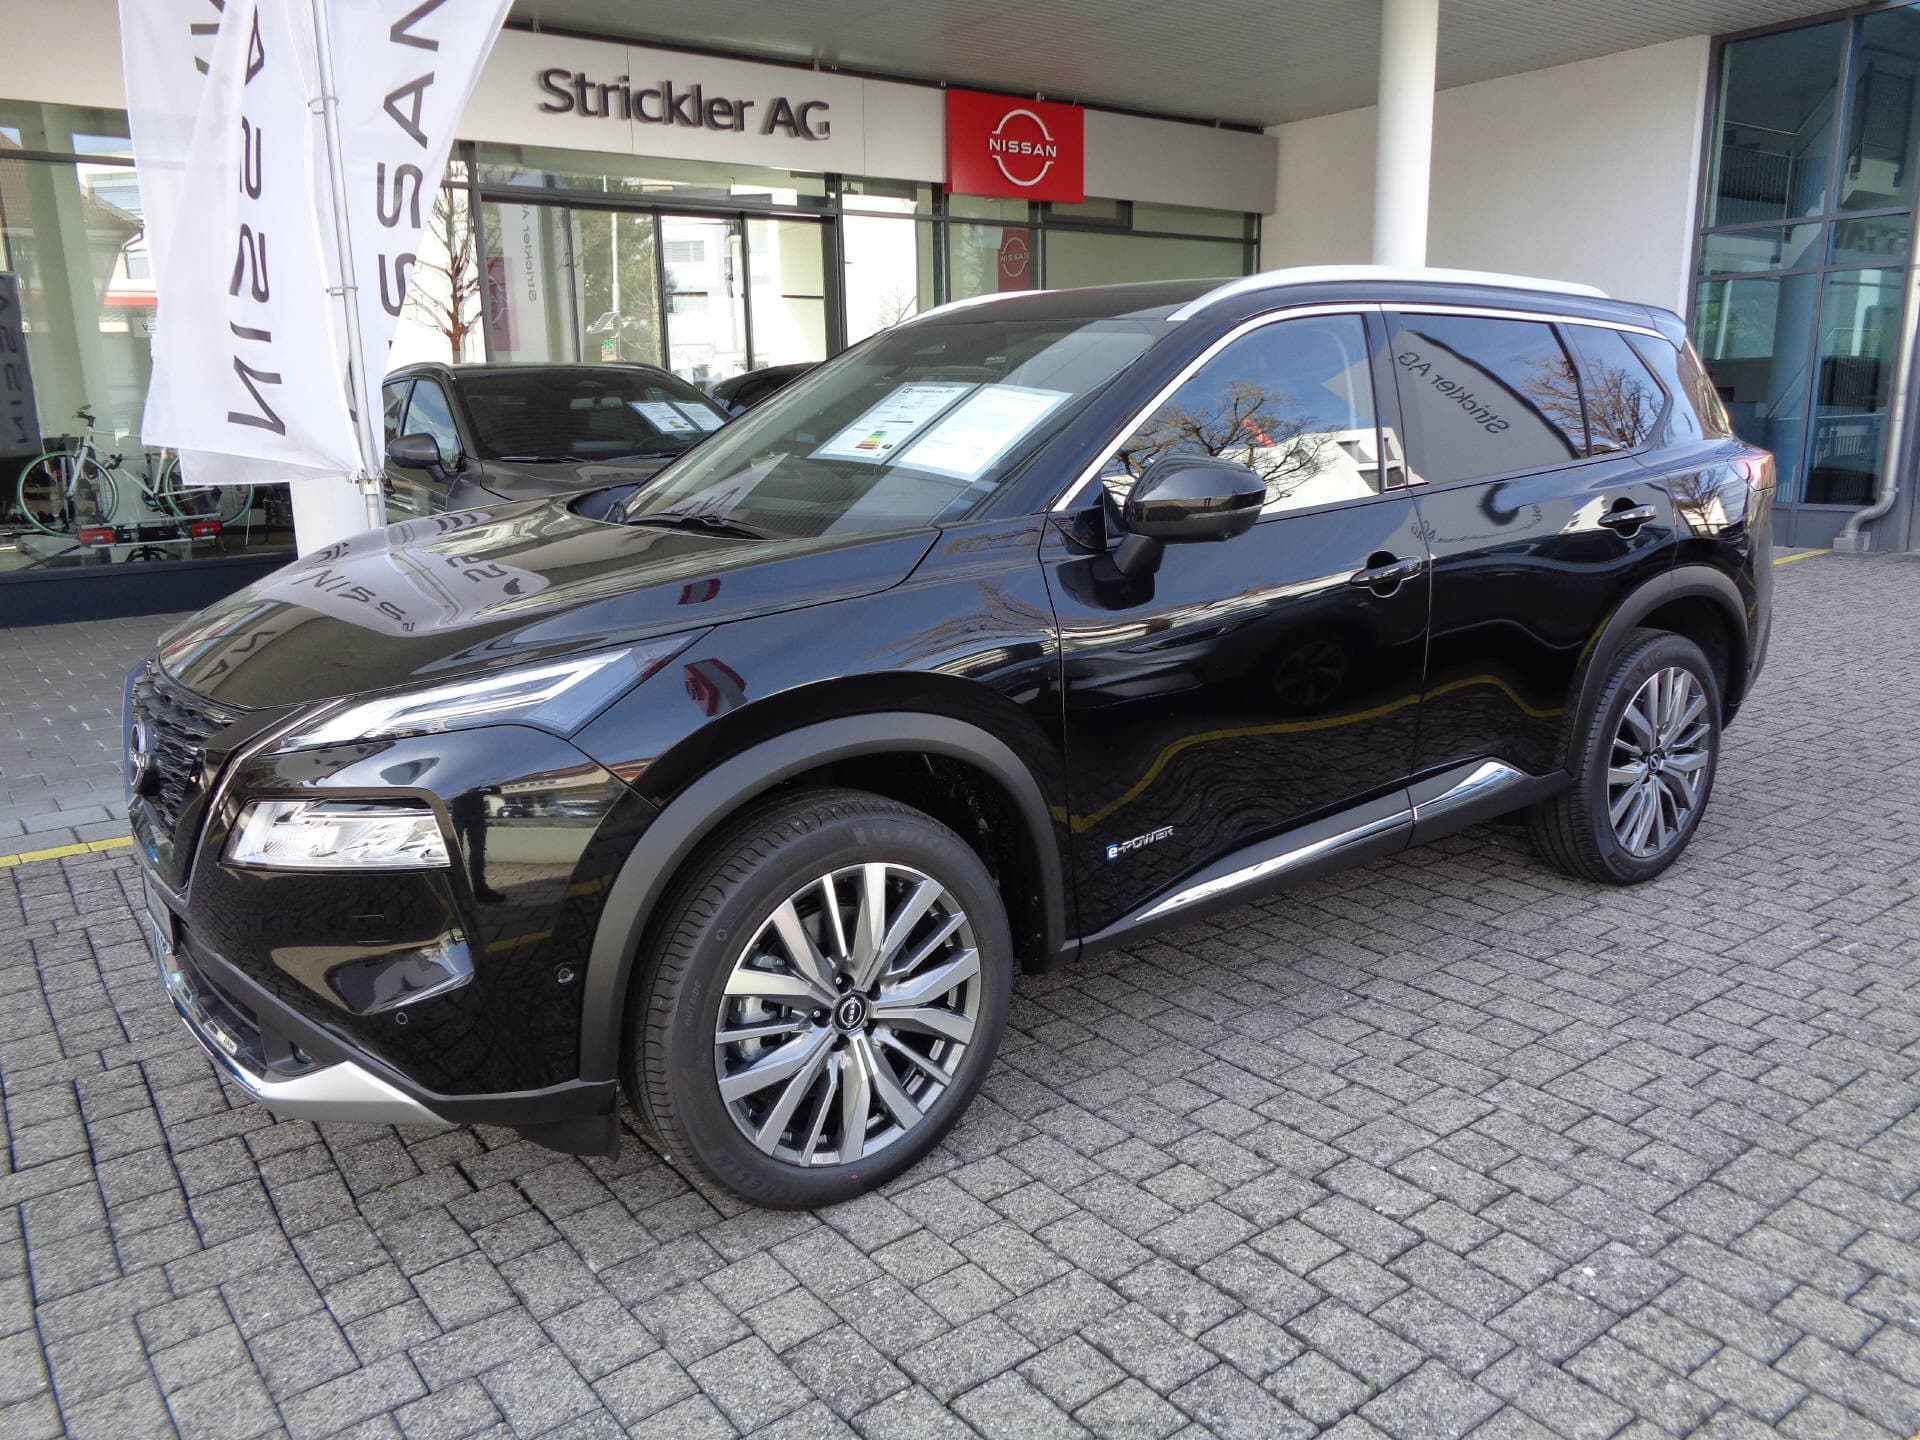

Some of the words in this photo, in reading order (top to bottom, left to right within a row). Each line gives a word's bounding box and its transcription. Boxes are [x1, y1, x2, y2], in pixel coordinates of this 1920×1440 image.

[539, 67, 755, 133] Strickler
[759, 96, 830, 141] AG
[988, 138, 1057, 158] NISSAN
[1106, 824, 1175, 861] e-POWER
